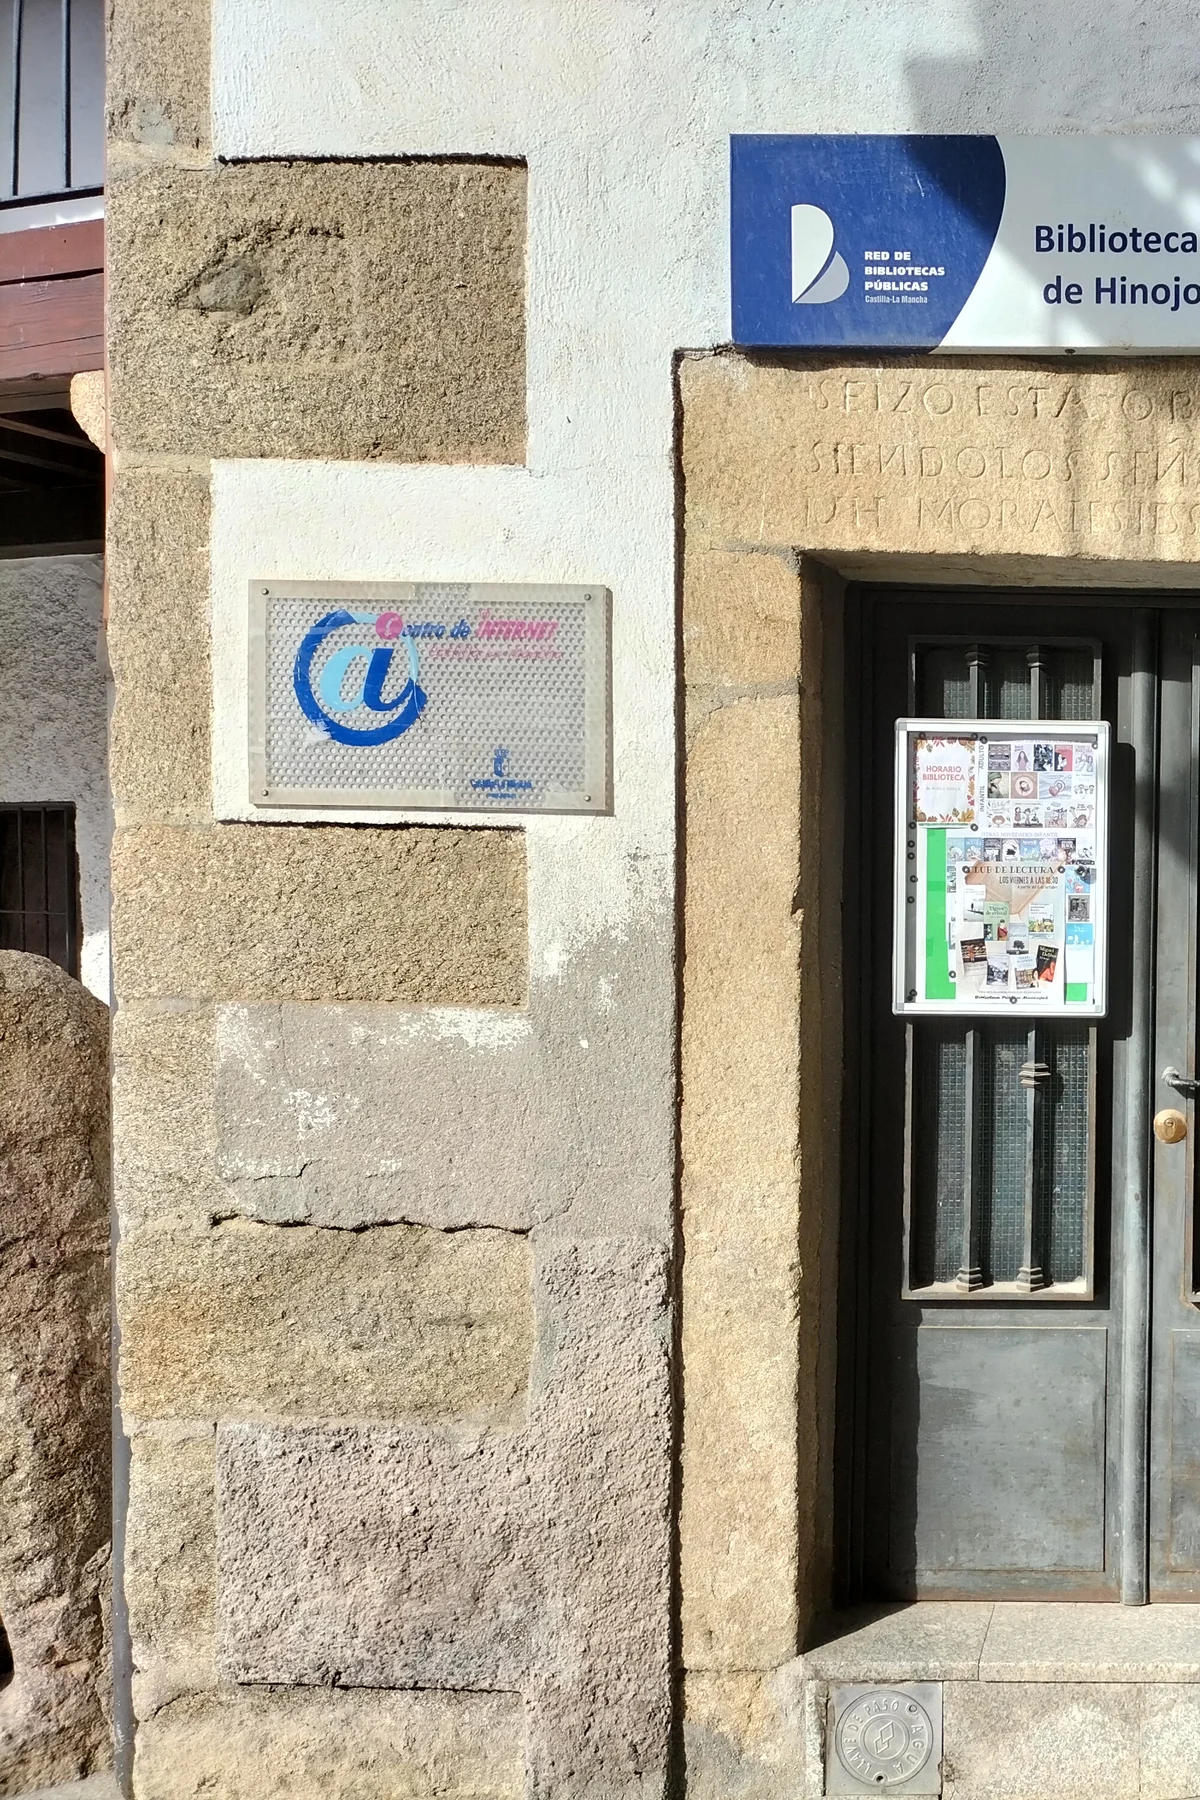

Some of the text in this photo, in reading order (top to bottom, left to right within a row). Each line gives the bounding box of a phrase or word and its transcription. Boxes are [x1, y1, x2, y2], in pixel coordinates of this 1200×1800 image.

[1035, 223, 1198, 253] Biblioteca
[864, 251, 911, 261] RED DE
[864, 266, 946, 276] BIBLIOTECAS
[864, 280, 929, 291] PÚBLICAS
[1043, 275, 1083, 305] de
[865, 295, 928, 304] Castilla-La Mancha
[450, 618, 472, 639] de
[926, 765, 962, 773] HORARIO
[922, 773, 966, 781] BIBLIOTECA
[995, 865, 1008, 874] DE
[1009, 866, 1055, 874] LECTURA
[999, 876, 1009, 885] LOS
[863, 1698, 900, 1716] PASO
